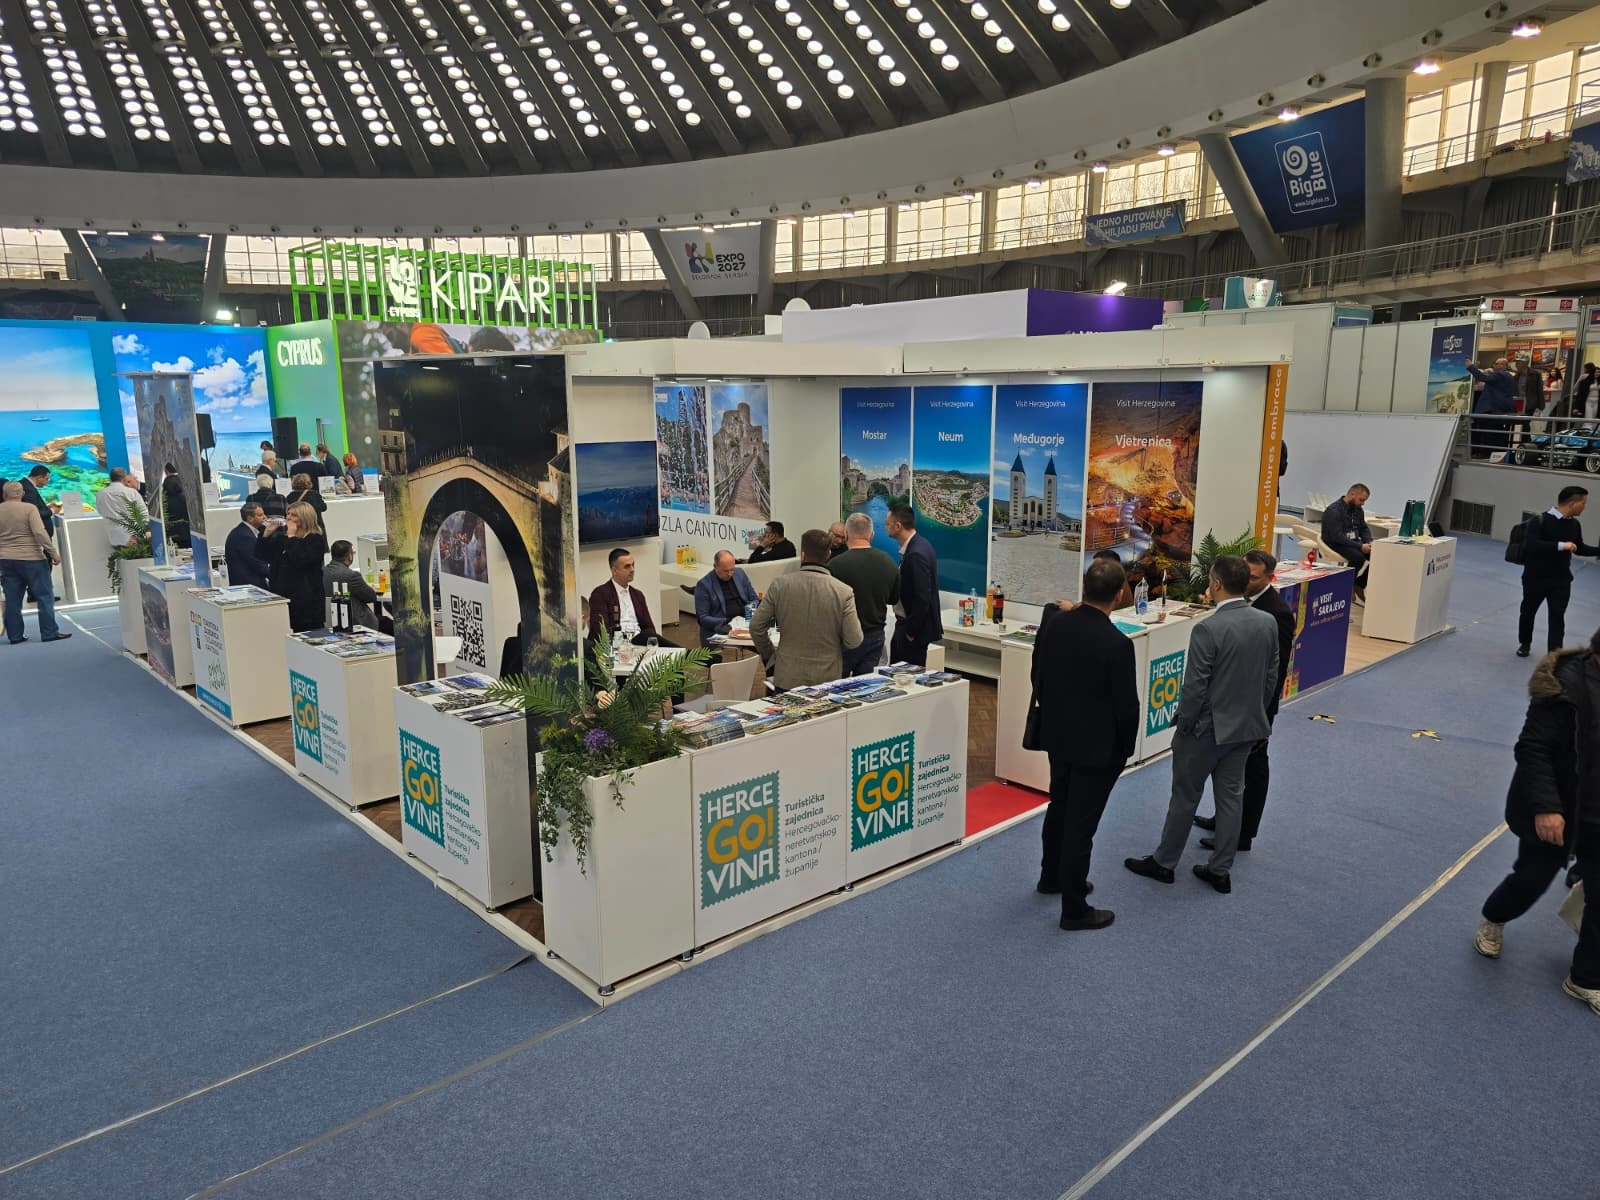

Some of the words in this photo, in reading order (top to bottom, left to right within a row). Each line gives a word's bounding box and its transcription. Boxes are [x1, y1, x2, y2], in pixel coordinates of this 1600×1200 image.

[1309, 150, 1327, 191] Blue
[1289, 178, 1313, 198] Big
[1096, 217, 1121, 229] JEDNO
[1105, 225, 1138, 237] HILJADU
[716, 253, 745, 263] EXPO
[718, 262, 746, 272] 2027
[428, 270, 551, 315] KIPAR
[277, 338, 323, 366] CYPRUS
[1029, 400, 1066, 409] Herzegovina
[1116, 399, 1131, 407] Visit
[1132, 400, 1176, 409] Herzegovina
[862, 430, 888, 441] Mostar
[938, 432, 964, 442] Neum
[1013, 432, 1065, 447] Međugorje
[1116, 435, 1172, 449] Vjetrenica
[1264, 445, 1275, 506] cultures
[1270, 368, 1282, 440] embrace
[686, 518, 737, 542] CANTON
[1318, 599, 1346, 616] SARAJEVO
[1153, 656, 1182, 680] HERCE
[292, 677, 316, 703] HERCE
[1151, 673, 1182, 709] GO!
[294, 693, 319, 735] GO!
[296, 725, 320, 757] VINA
[403, 737, 438, 774] HERCE
[857, 740, 910, 775] HERCE
[404, 759, 440, 811] GO!
[918, 765, 949, 781] zajednica
[856, 763, 910, 812] GO!
[707, 781, 774, 824] HERCE
[784, 793, 825, 813] Turistička
[918, 801, 943, 816] kantona
[406, 795, 441, 839] VINA
[785, 807, 823, 826] zajednica
[856, 801, 908, 840] VINA
[707, 807, 774, 865] GO!
[785, 827, 836, 852] neretvanskog
[785, 847, 817, 864] kantona
[707, 848, 774, 895] VINA
[785, 859, 818, 878] županije
